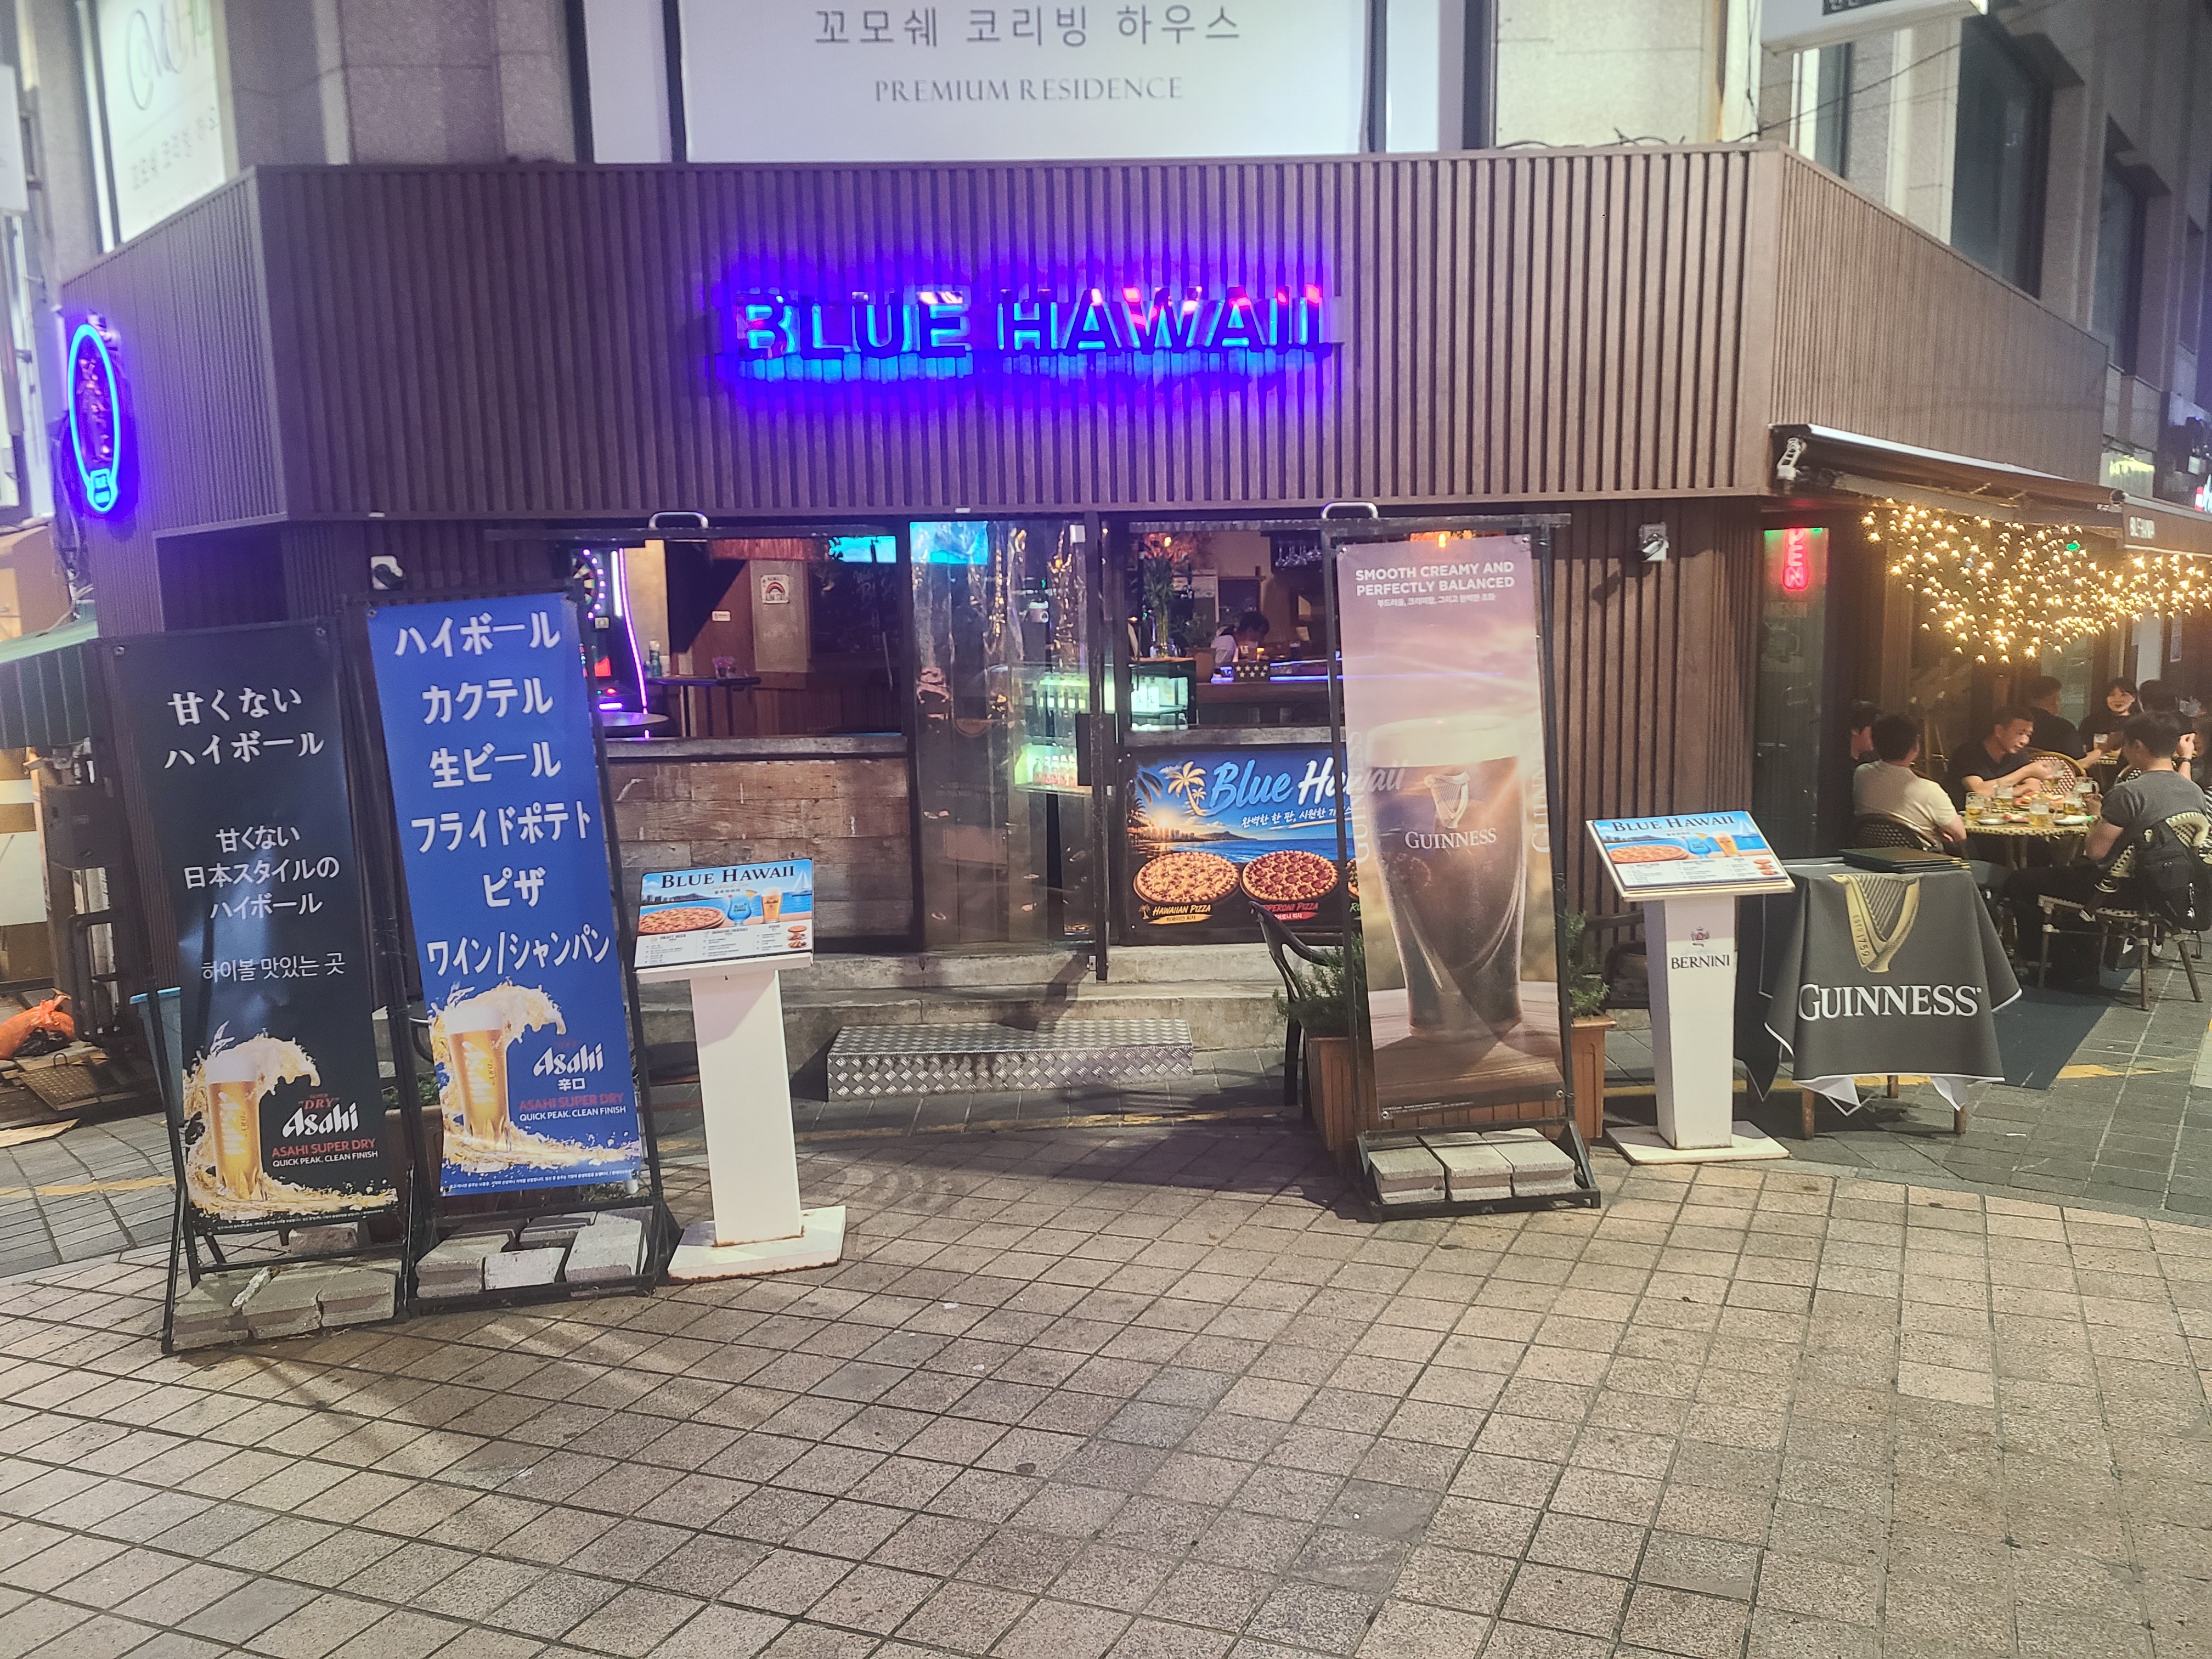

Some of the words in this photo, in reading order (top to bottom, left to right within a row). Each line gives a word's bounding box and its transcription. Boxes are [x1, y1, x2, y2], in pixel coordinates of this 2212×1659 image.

[815, 7, 938, 47] 꼬모쉐
[966, 6, 1087, 48] 코리빙
[1116, 4, 1240, 44] 하우스
[876, 79, 1009, 102] PREMIUM
[1019, 76, 1183, 101] RESIDENCE
[736, 290, 972, 358] BLUE
[998, 287, 1319, 353] HAWAII
[1356, 567, 1417, 581] SMOOTH
[1420, 563, 1480, 577] CREAMY
[1483, 561, 1515, 574] AND
[1357, 581, 1436, 596] PERFECTLY
[1439, 577, 1515, 591] BALANCED
[394, 611, 561, 658] ハイボール
[167, 687, 302, 726] 甘くない
[422, 677, 553, 725] カクテル
[165, 730, 325, 769] ハイボール
[430, 741, 561, 788] 生ビール
[1210, 759, 1294, 809] Blue
[411, 800, 591, 853] フライドポテト
[1241, 814, 1269, 828] 완벽한
[1271, 812, 1282, 823] 한
[1284, 810, 1296, 822] 판,
[1299, 807, 1325, 819] 시원한
[1611, 821, 1662, 832] BLUE
[1664, 816, 1735, 828] HAWAII
[216, 825, 300, 853] 甘くない
[1404, 828, 1497, 849] GUINNESS
[184, 856, 340, 889] 日本スタイルの
[661, 873, 715, 888] BLUE
[723, 865, 795, 883] HAWAII
[483, 867, 546, 907] ピザ
[210, 893, 323, 919] ハイボール
[1153, 905, 1189, 916] HAWAIIAN
[1189, 904, 1211, 913] PIZZA
[1296, 902, 1319, 911] PIZZA
[427, 923, 610, 976] ワイン/シャンパン
[1857, 934, 1870, 956] 1759
[201, 958, 256, 983] 하이볼
[261, 955, 320, 979] 맛있는
[324, 952, 345, 975] 곳
[1671, 955, 1729, 969] BERNINI
[1798, 984, 1978, 1021] GUINNESS
[533, 1043, 603, 1077] Asahi
[558, 1077, 585, 1091] 辛口
[519, 1098, 556, 1111] ASAHI
[558, 1094, 597, 1107] SUPER
[599, 1092, 623, 1104] DRY
[520, 1111, 546, 1121] QUICK
[548, 1110, 571, 1119] PEAK.
[572, 1108, 599, 1117] CLEAN
[600, 1105, 626, 1115] FINISH
[282, 1102, 358, 1138] Asahi
[272, 1144, 308, 1157] ASAHI
[309, 1141, 349, 1153] SUPER
[352, 1138, 376, 1150] DRY
[273, 1158, 298, 1167] QUICK
[300, 1156, 324, 1164] PEAK.
[325, 1153, 351, 1162] CLEAN
[352, 1150, 379, 1160] FINISH
